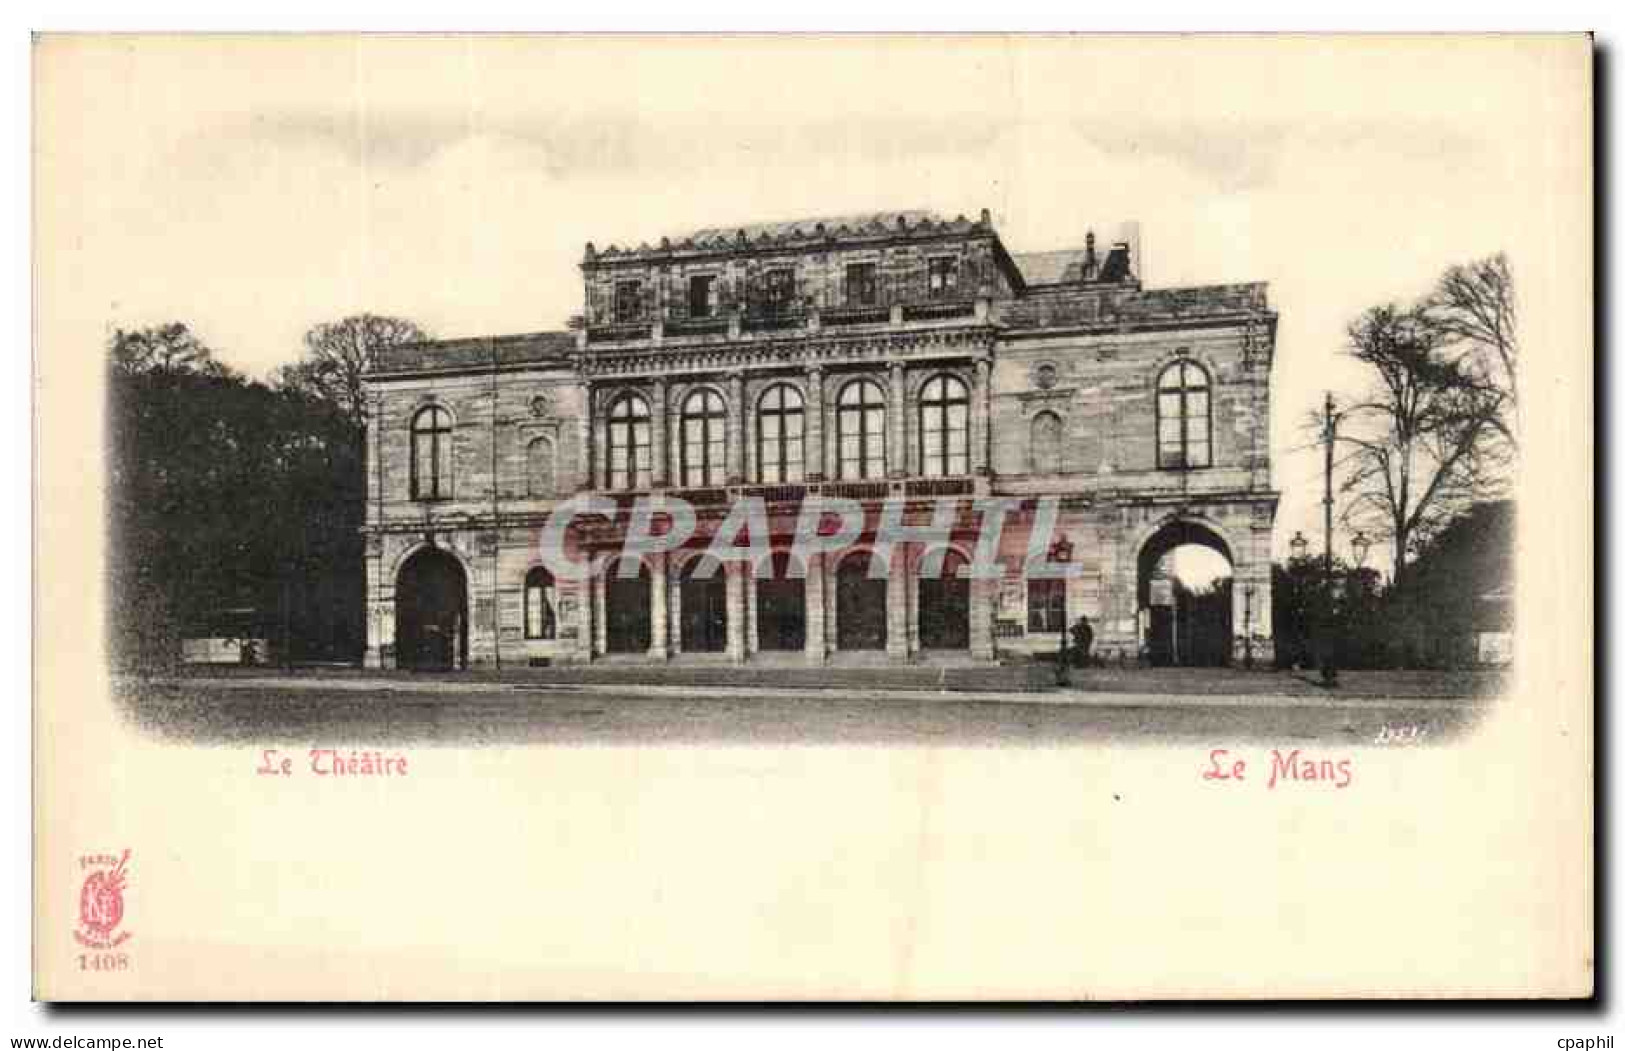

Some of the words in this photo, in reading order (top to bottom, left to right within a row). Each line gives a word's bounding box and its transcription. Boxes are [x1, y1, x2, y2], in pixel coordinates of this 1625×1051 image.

[256, 749, 293, 776] Le
[1202, 749, 1246, 781] Le
[1266, 749, 1352, 789] Mans
